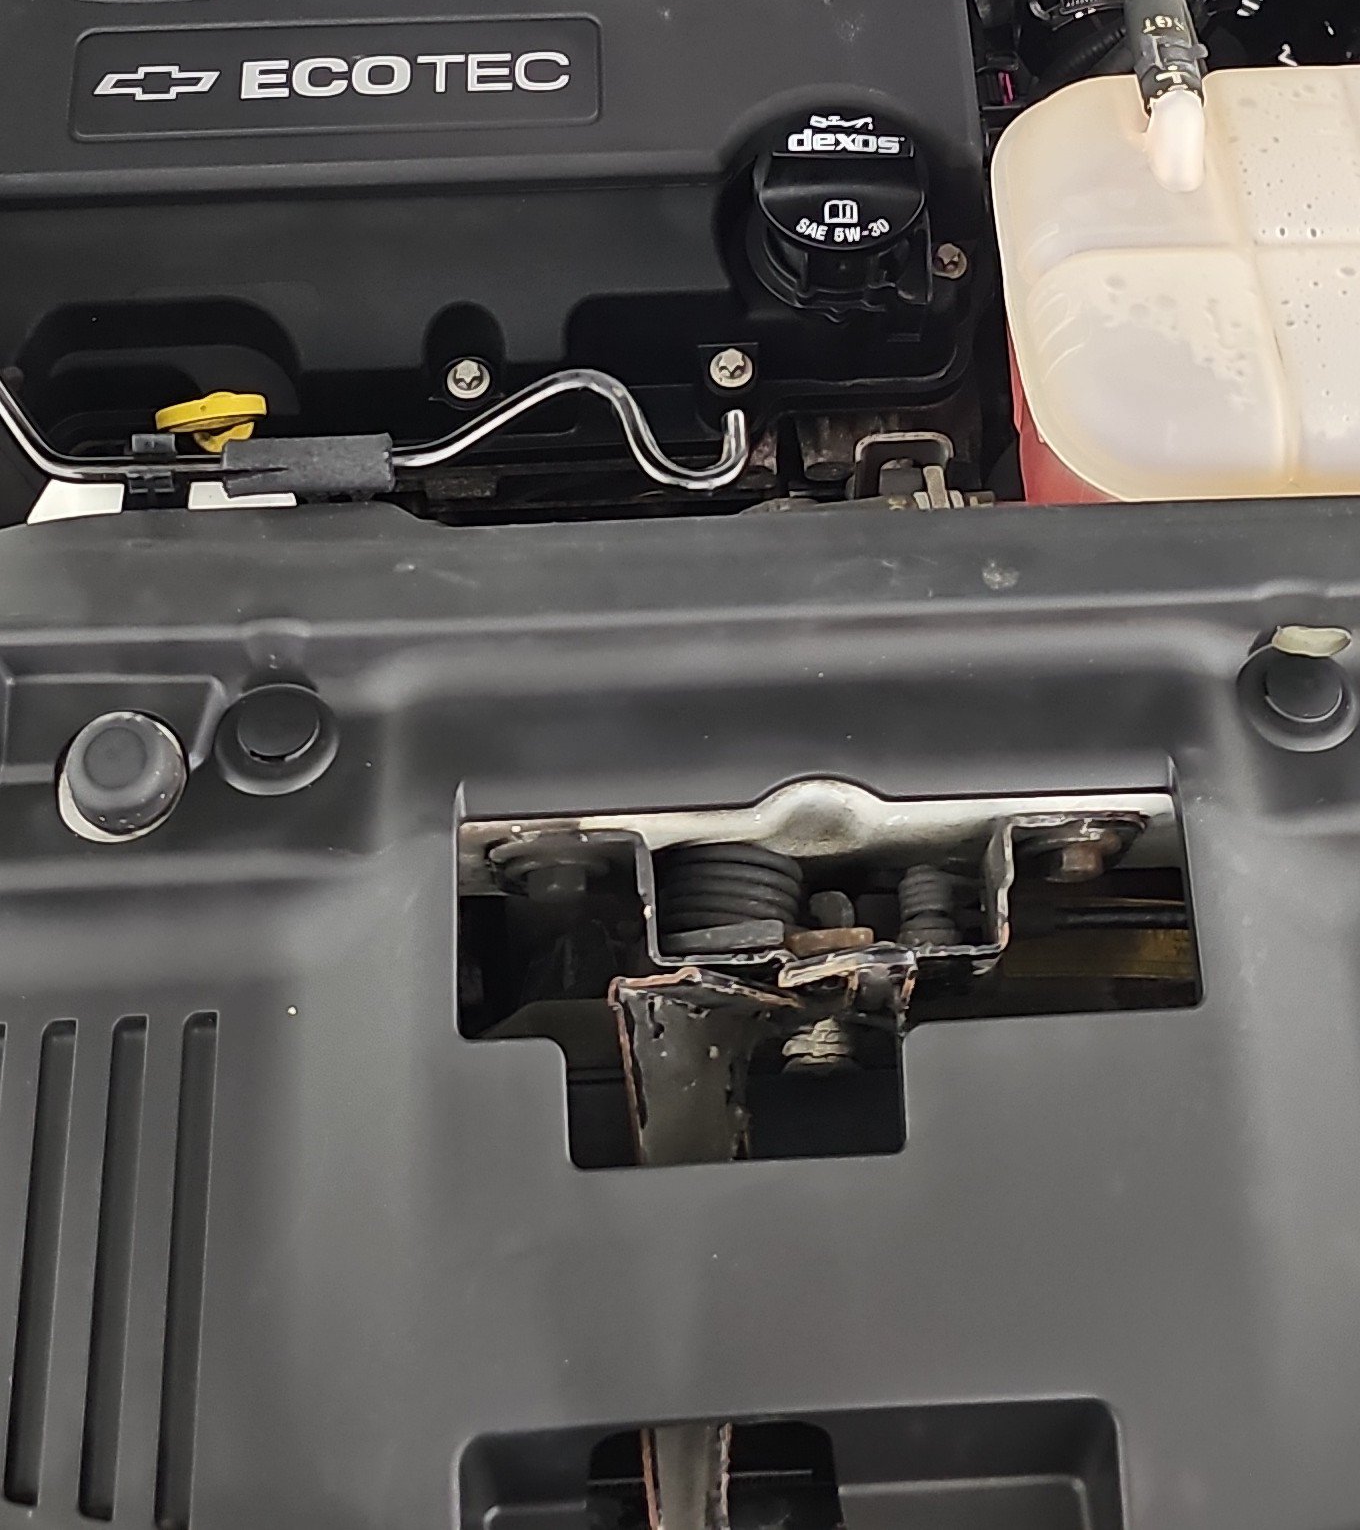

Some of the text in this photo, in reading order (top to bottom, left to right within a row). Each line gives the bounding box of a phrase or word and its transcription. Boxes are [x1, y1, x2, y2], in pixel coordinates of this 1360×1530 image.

[240, 51, 571, 100] ECOTEC
[787, 129, 900, 154] dexos
[795, 218, 890, 243] SAE 5W-30
